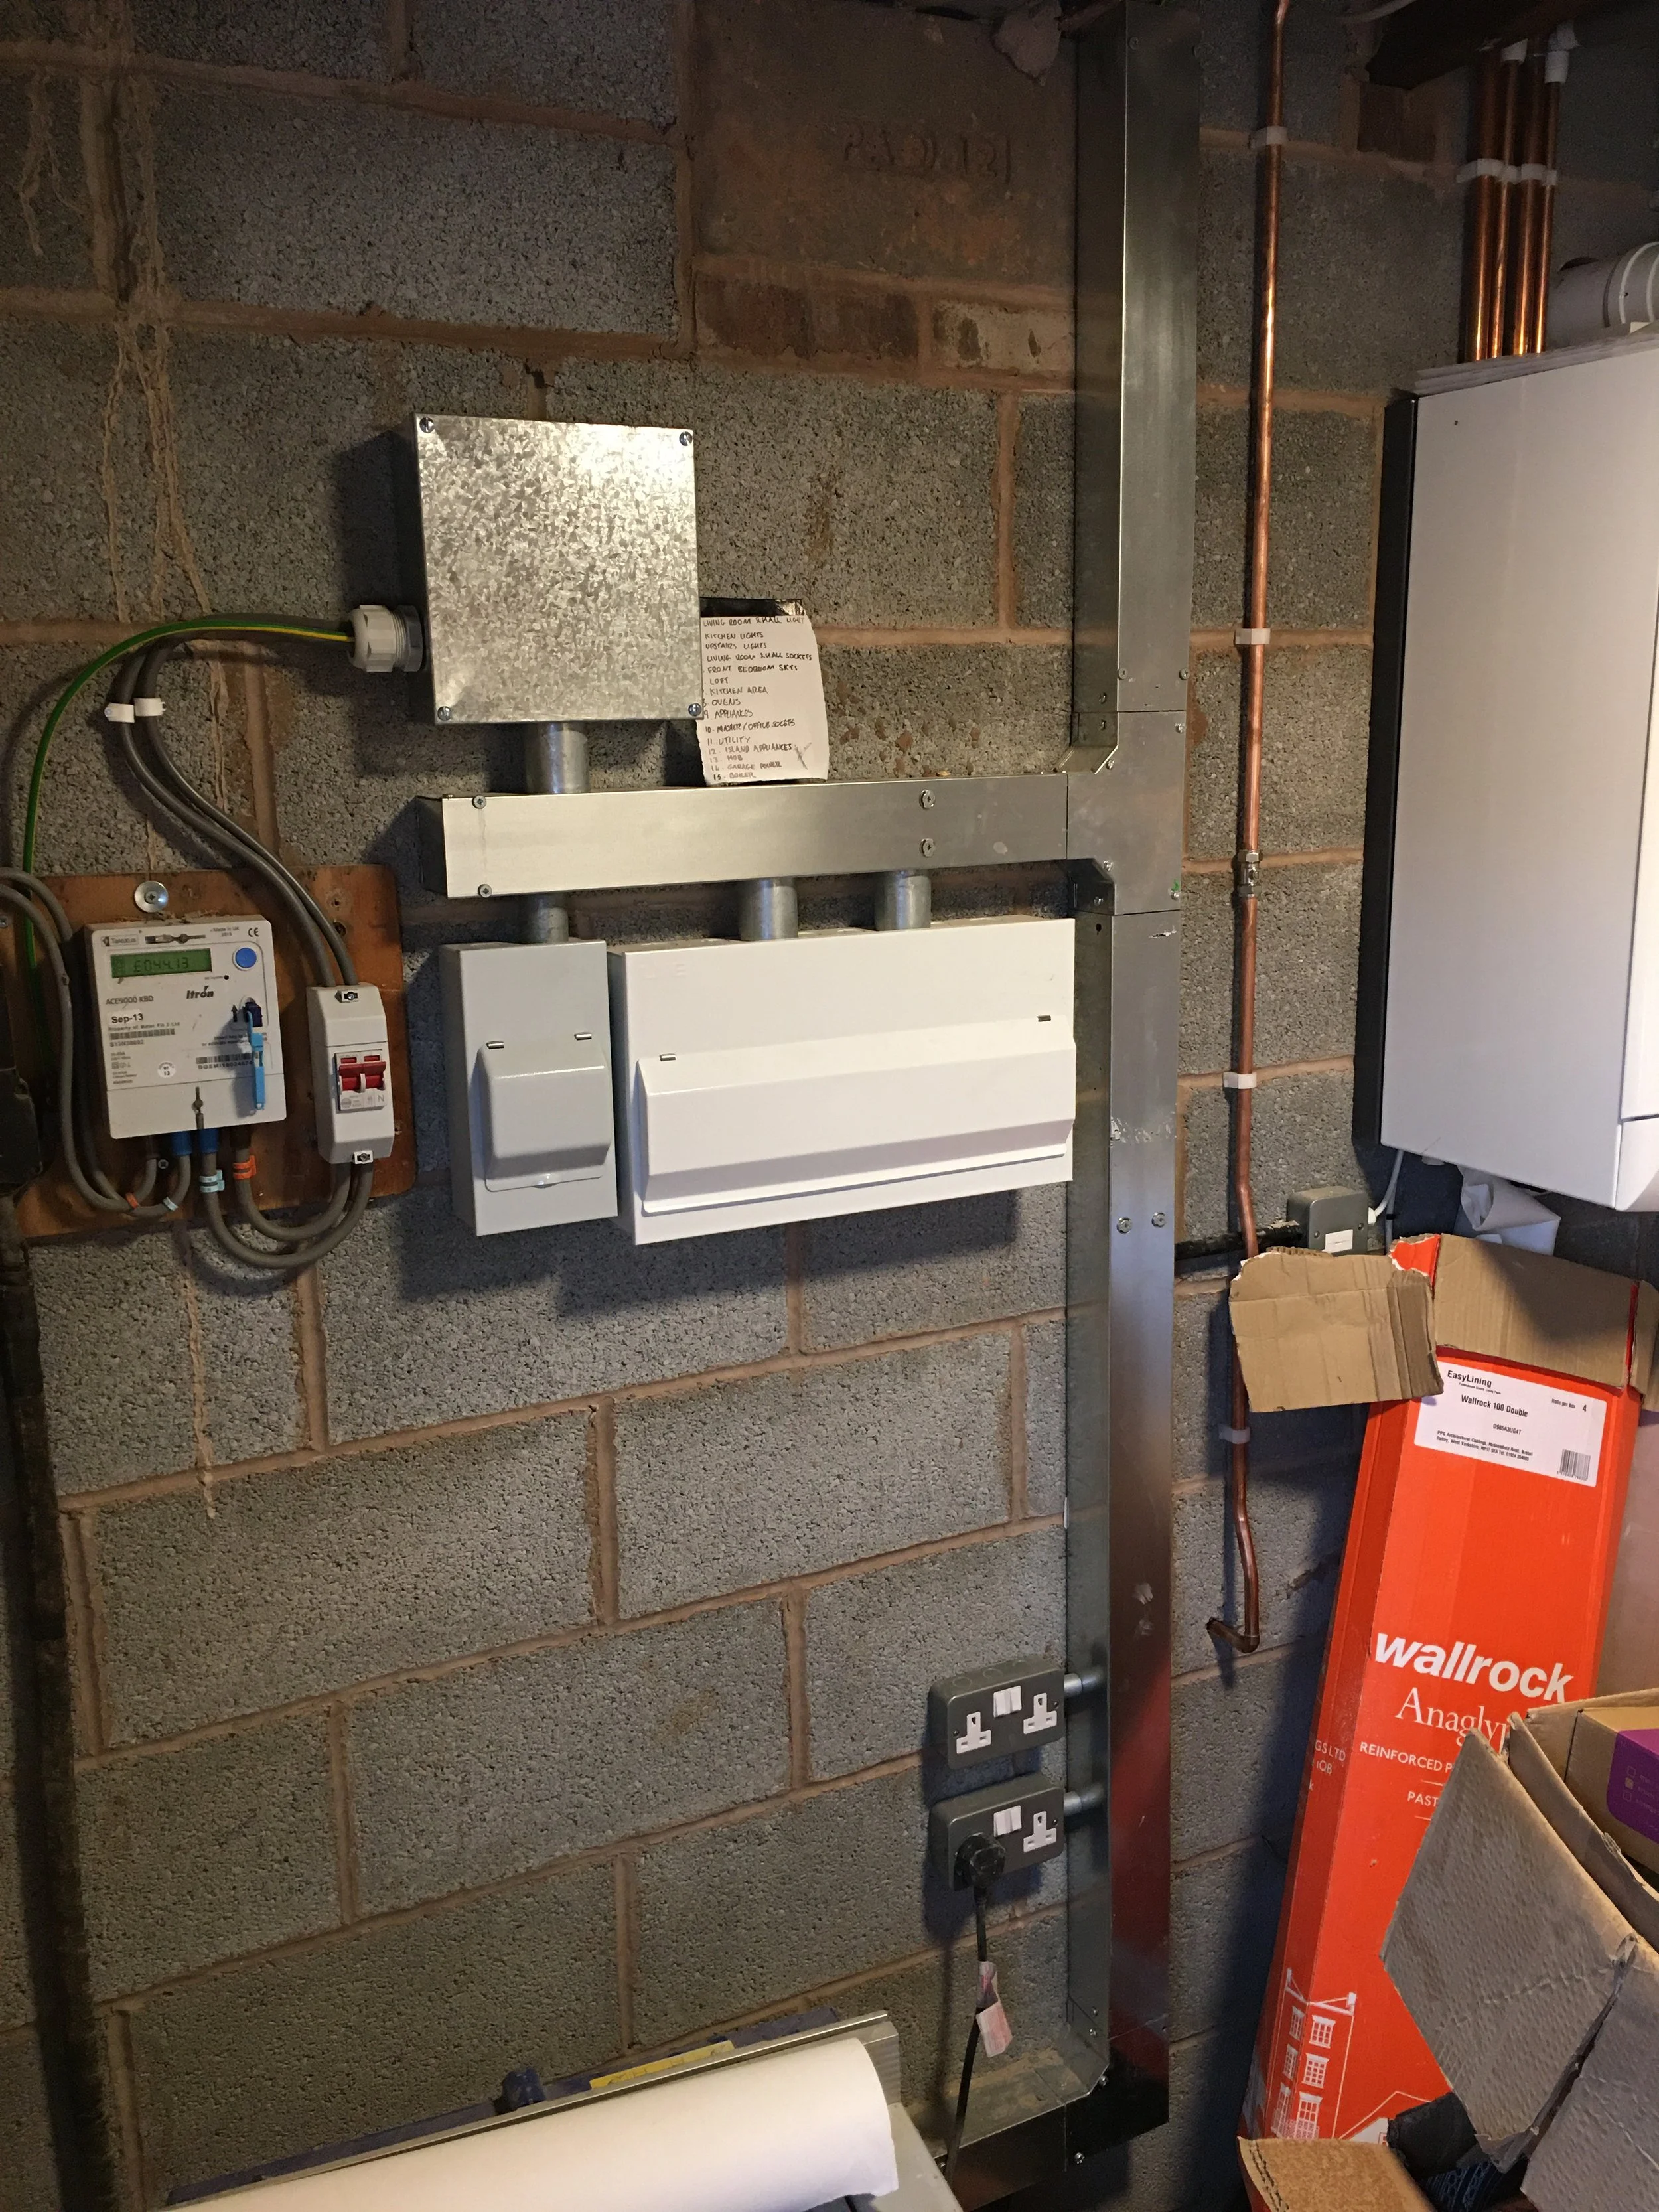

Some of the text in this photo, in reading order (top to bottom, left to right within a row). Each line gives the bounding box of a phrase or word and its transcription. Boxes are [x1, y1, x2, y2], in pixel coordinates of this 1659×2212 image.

[707, 665, 732, 674] FRONT
[737, 664, 775, 673] BEDROOM
[710, 687, 743, 696] KITCHEN
[714, 709, 754, 720] APPLIANCES
[719, 735, 751, 745] UTILITY
[760, 761, 782, 770] POWER
[111, 1013, 144, 1025] Sep-13
[1447, 1370, 1492, 1388] EasyLining
[1461, 1394, 1528, 1418] Wallrock 100 Double
[1374, 1631, 1574, 1703] wallrock
[1328, 1745, 1346, 1761] LTD
[1360, 1741, 1443, 1772] REINFORCED
